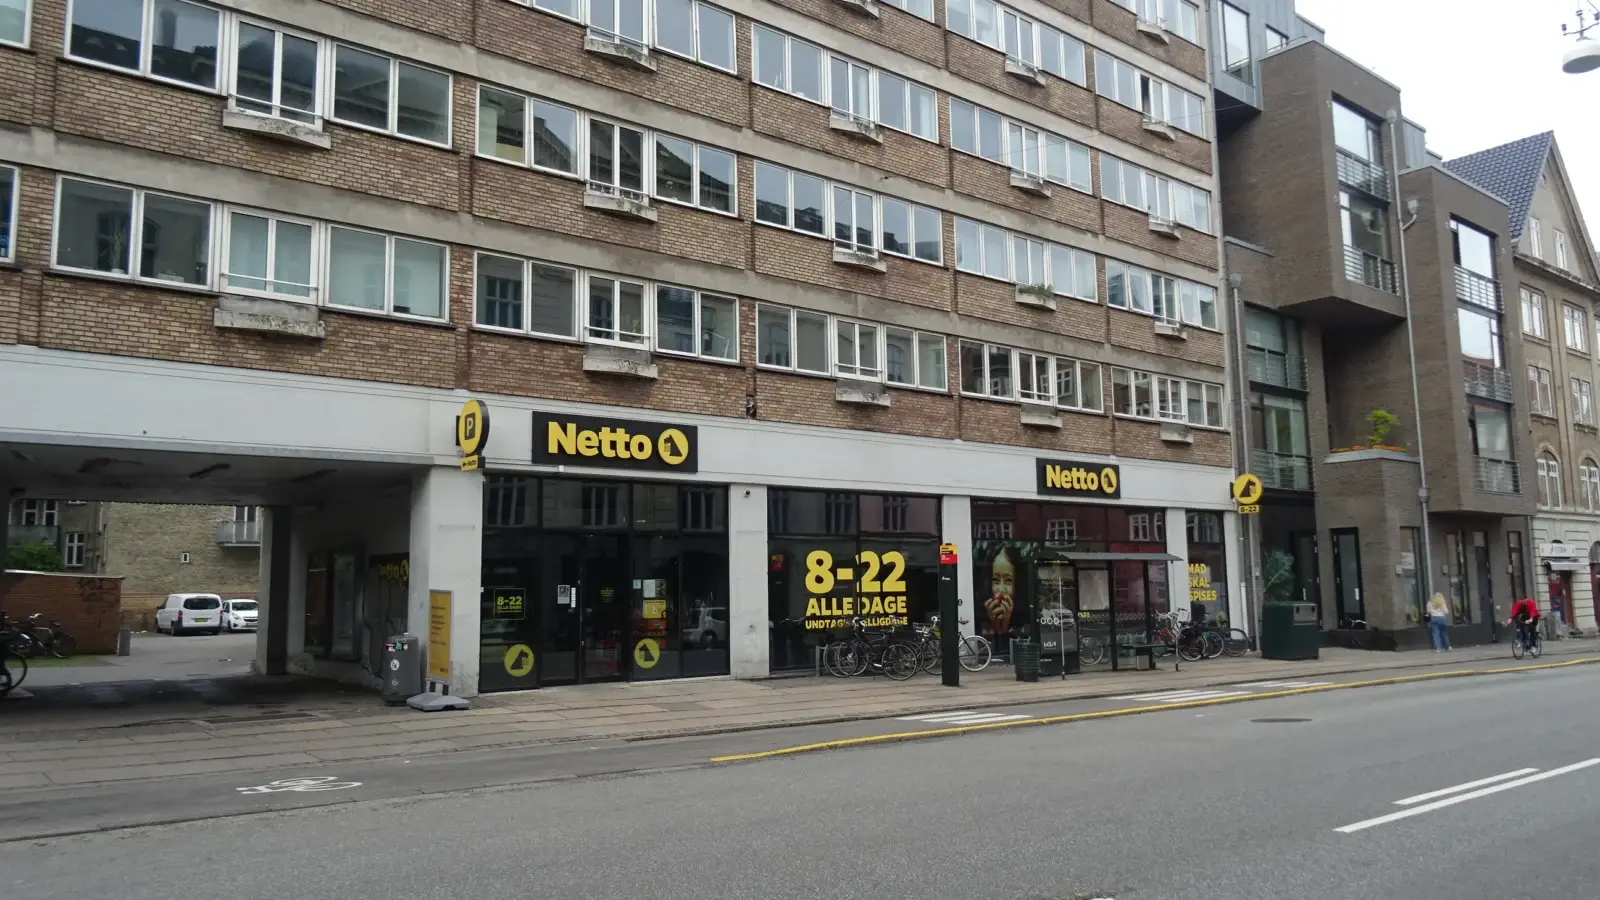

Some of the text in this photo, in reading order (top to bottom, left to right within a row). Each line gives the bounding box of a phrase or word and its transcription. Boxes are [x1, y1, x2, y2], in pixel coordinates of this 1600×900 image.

[466, 417, 473, 437] P
[547, 421, 652, 460] Netto
[1045, 464, 1099, 491] Netto
[805, 550, 906, 594] 8-22
[1188, 563, 1207, 574] MAD
[497, 596, 522, 605] 8-22
[805, 595, 907, 617] ALLE DAGE
[805, 619, 852, 629] UNDTAG
